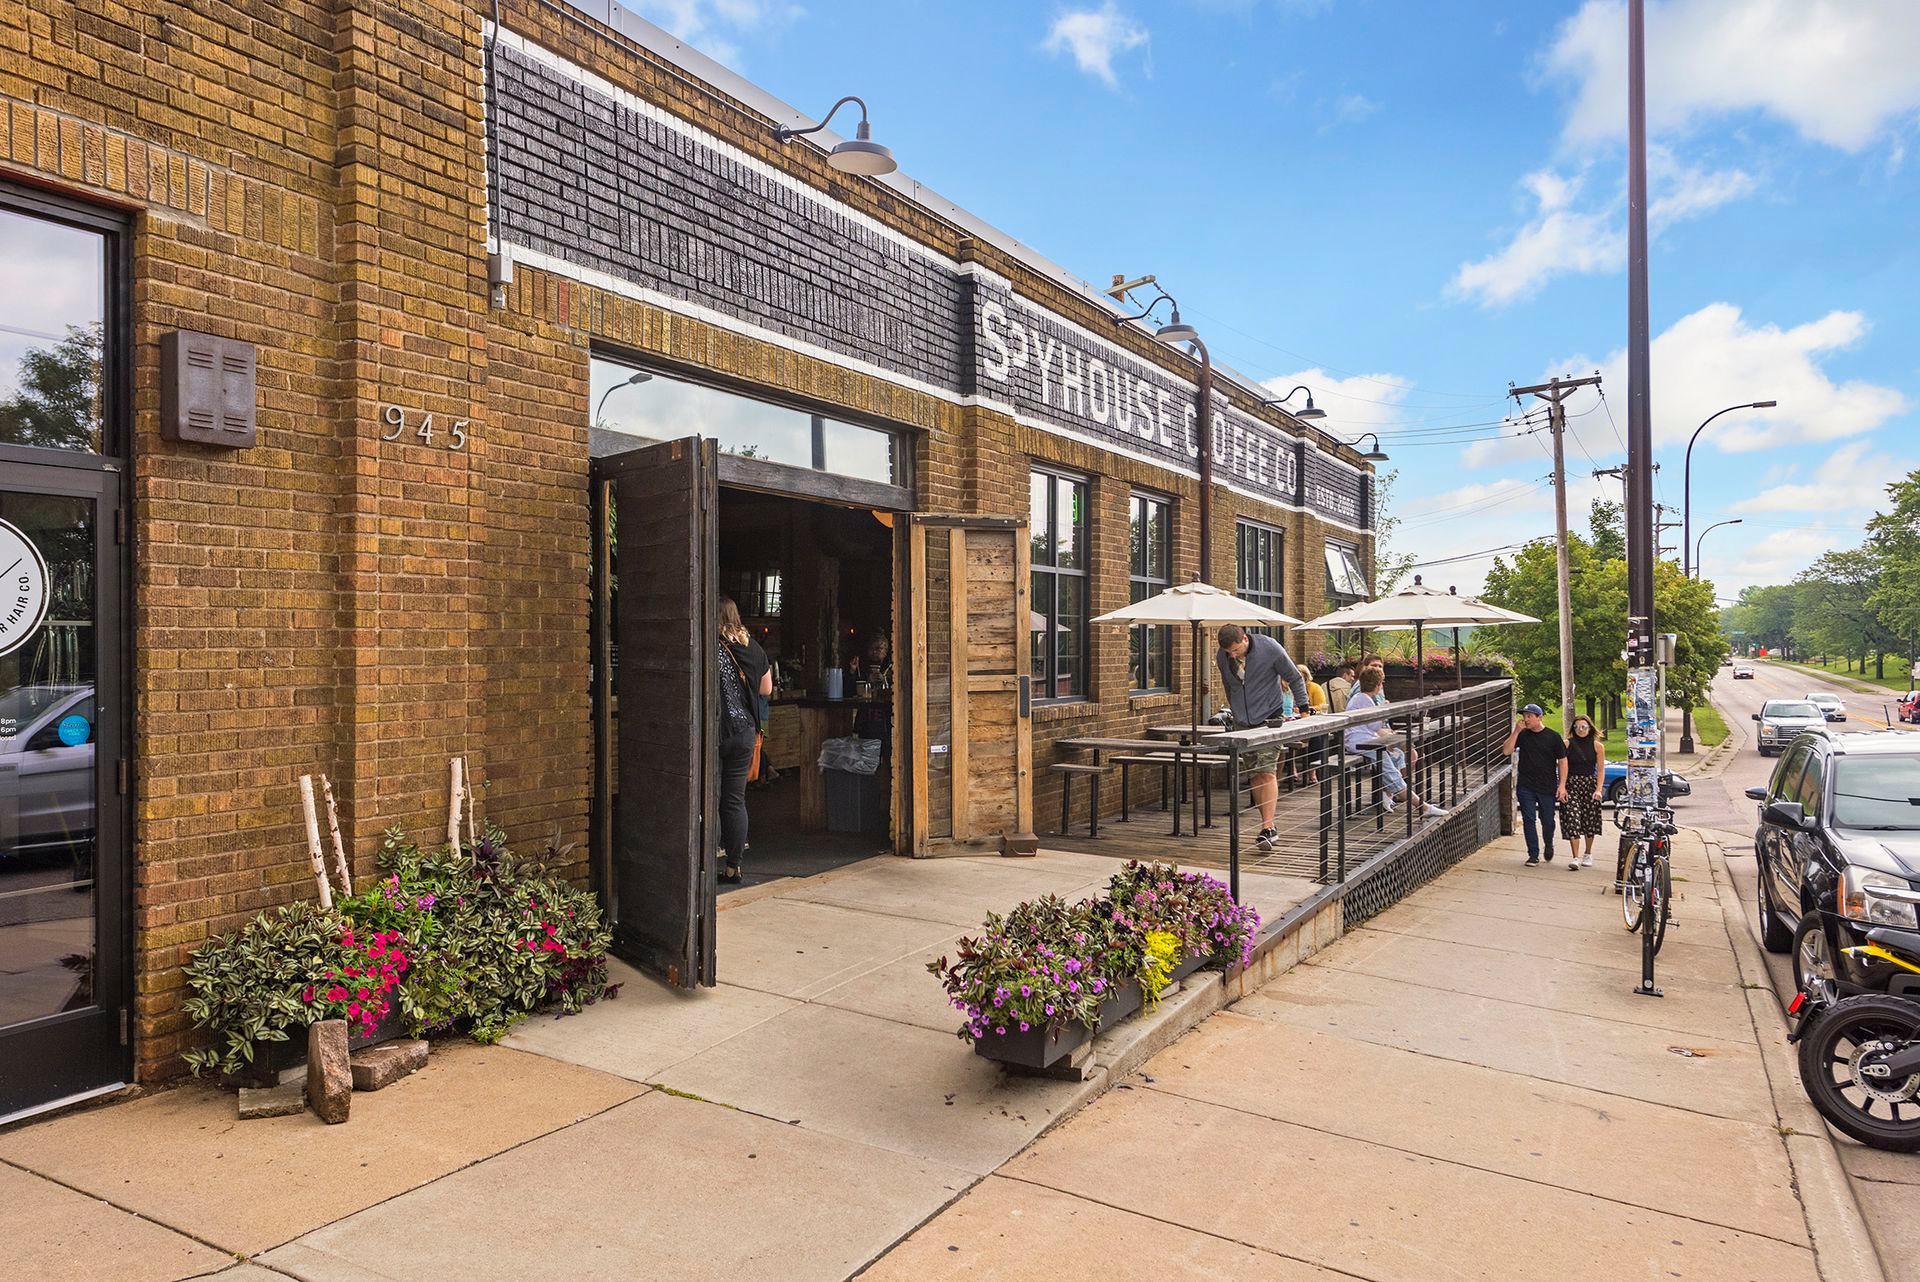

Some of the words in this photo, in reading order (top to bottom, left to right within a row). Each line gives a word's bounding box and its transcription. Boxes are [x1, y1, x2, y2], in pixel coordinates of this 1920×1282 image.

[382, 405, 470, 449] 945
[6, 596, 29, 625] HAIR
[18, 571, 31, 592] CO.
[0, 718, 17, 726] 8pm
[0, 726, 17, 734] 6pm
